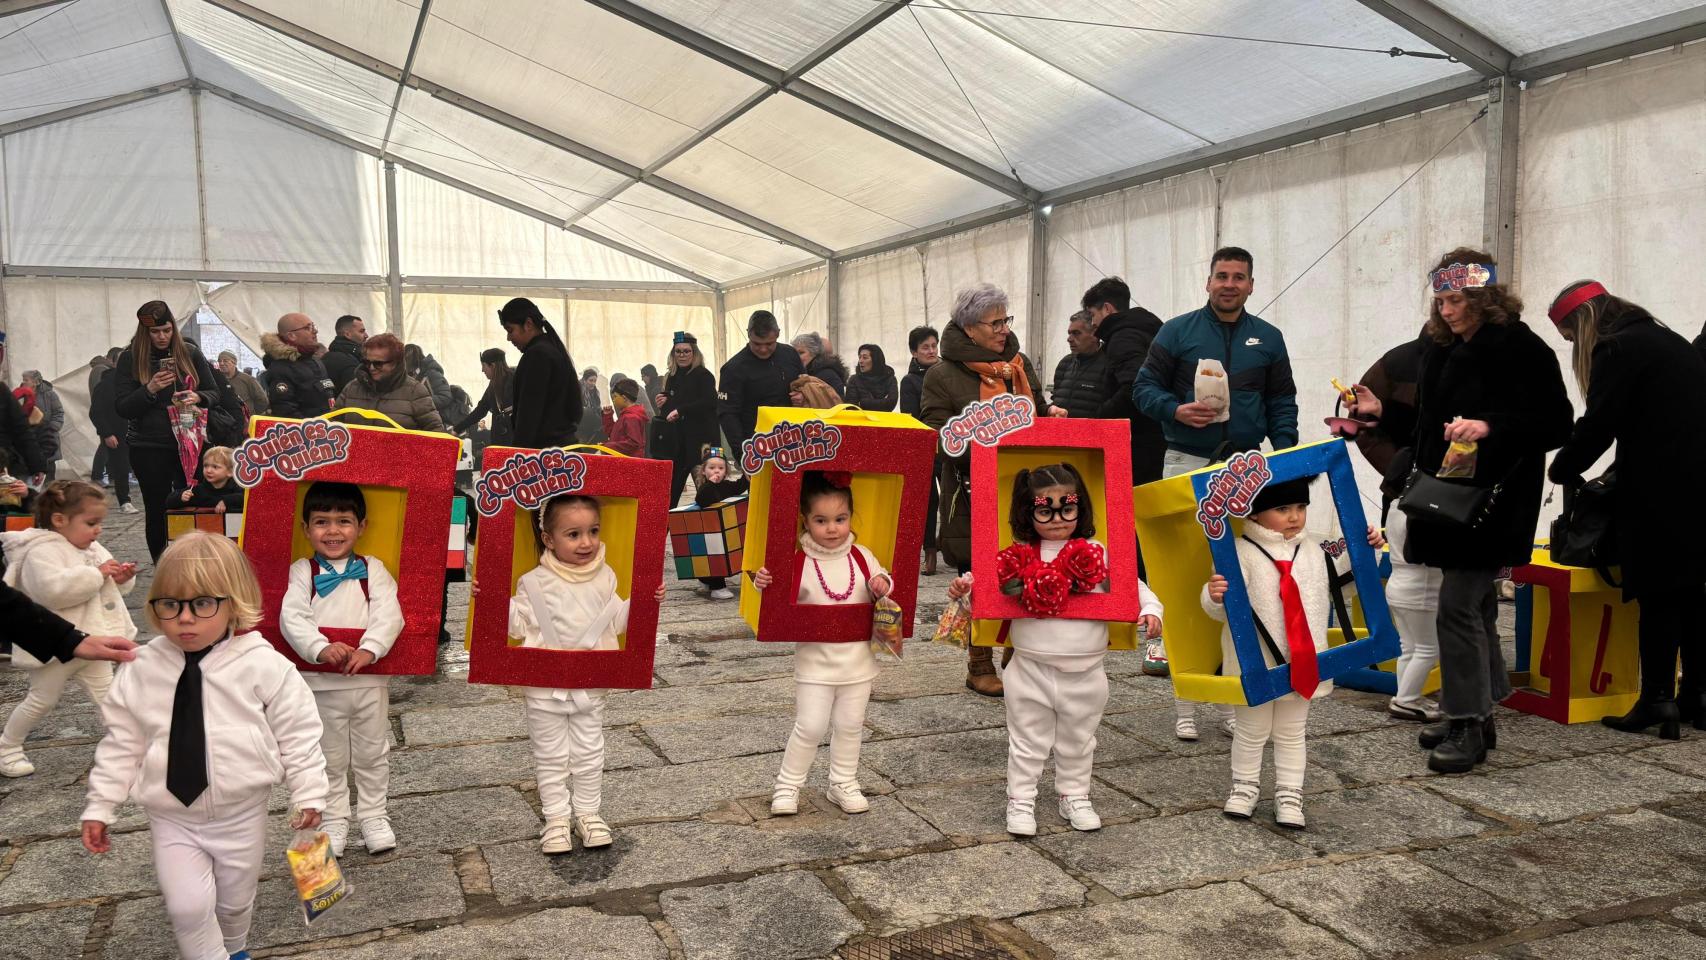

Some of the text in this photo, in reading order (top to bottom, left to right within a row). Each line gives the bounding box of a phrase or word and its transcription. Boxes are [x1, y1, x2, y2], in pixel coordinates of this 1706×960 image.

[744, 423, 823, 470] ¿Quién es
[944, 398, 1013, 453] ¿Quién es
[975, 400, 1031, 442] Quién?
[237, 422, 328, 481] ¿Quién es
[277, 428, 349, 475] Quién?
[776, 430, 839, 468] Quién?
[479, 453, 564, 512] ¿Quién es
[515, 458, 583, 505] Quién?
[1199, 457, 1249, 537] ¿Quién es
[1226, 454, 1270, 514] Quién?
